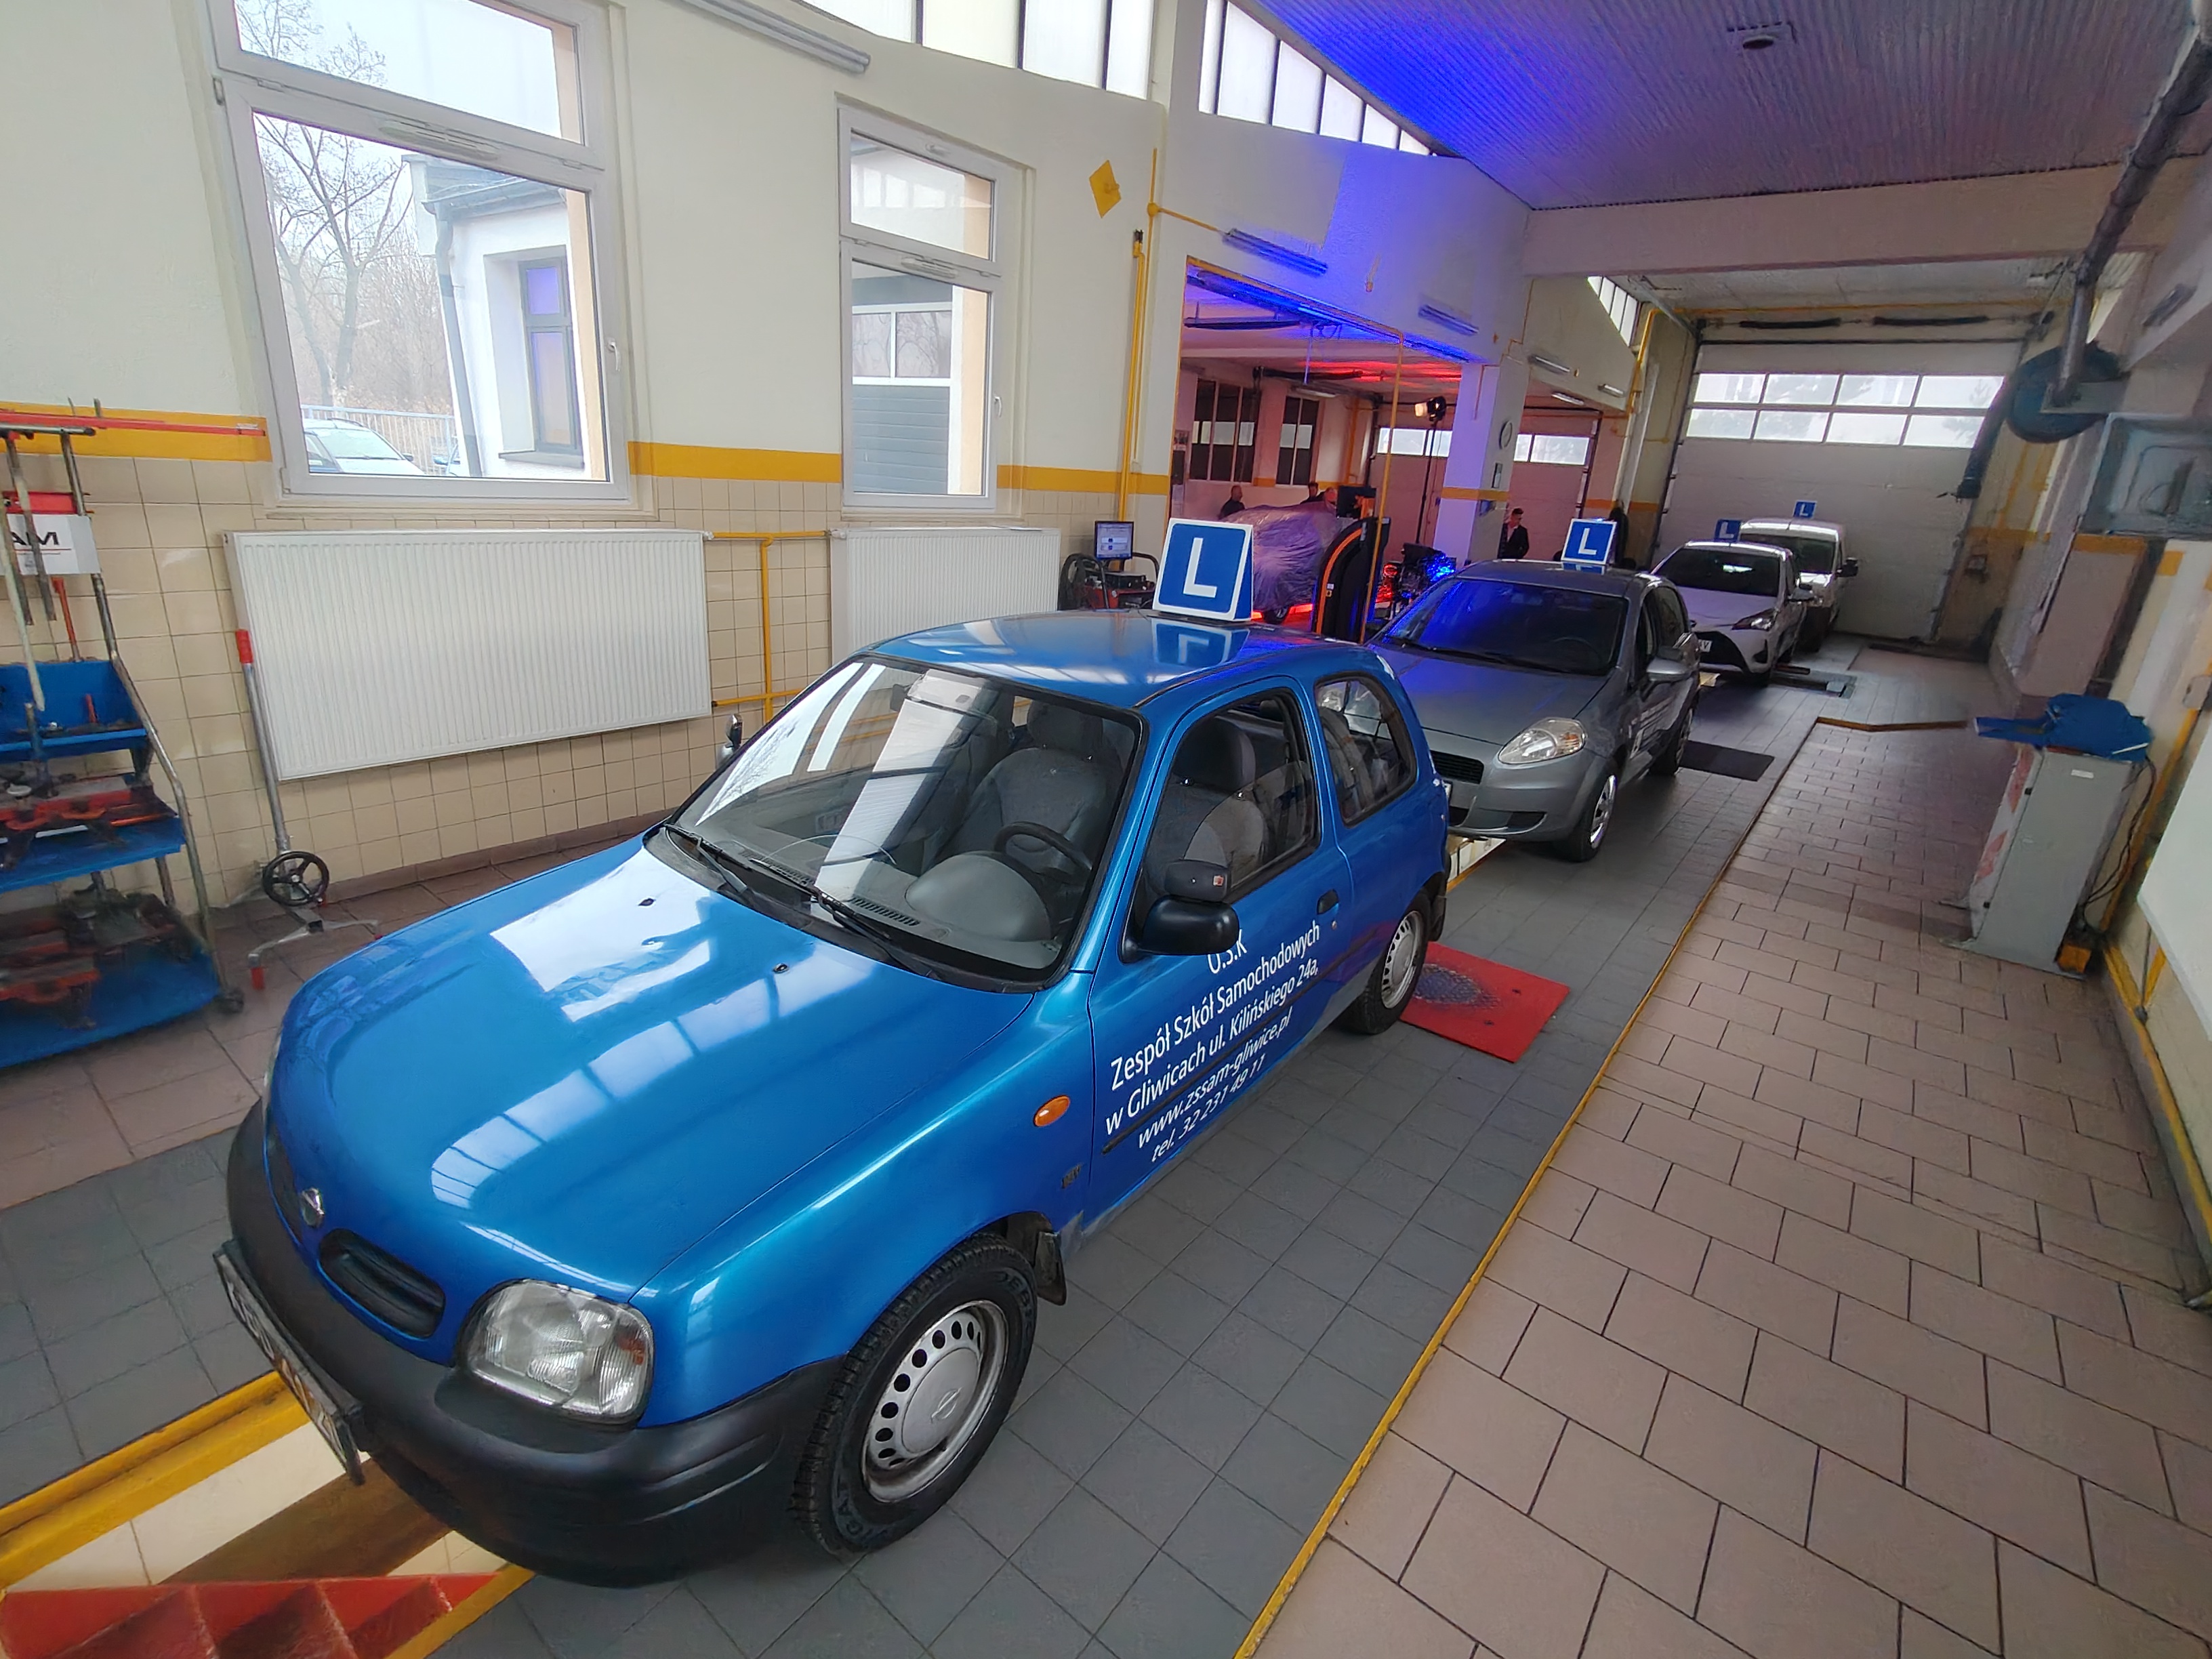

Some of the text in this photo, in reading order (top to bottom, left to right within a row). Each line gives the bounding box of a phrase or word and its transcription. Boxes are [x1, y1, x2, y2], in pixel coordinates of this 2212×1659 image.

[1578, 528, 1597, 555] L
[1719, 522, 1734, 538] L
[1799, 504, 1808, 516] L
[1183, 537, 1217, 598] L
[1106, 958, 1318, 1134] w Gliwicach ul. Kilińskiego 24a,
[1111, 920, 1319, 1091] Zespół Szkół Samochodowych
[1139, 1006, 1292, 1148] www.zssam-gliwice.pl
[1151, 1053, 1265, 1162] tel. 32 231 49 11
